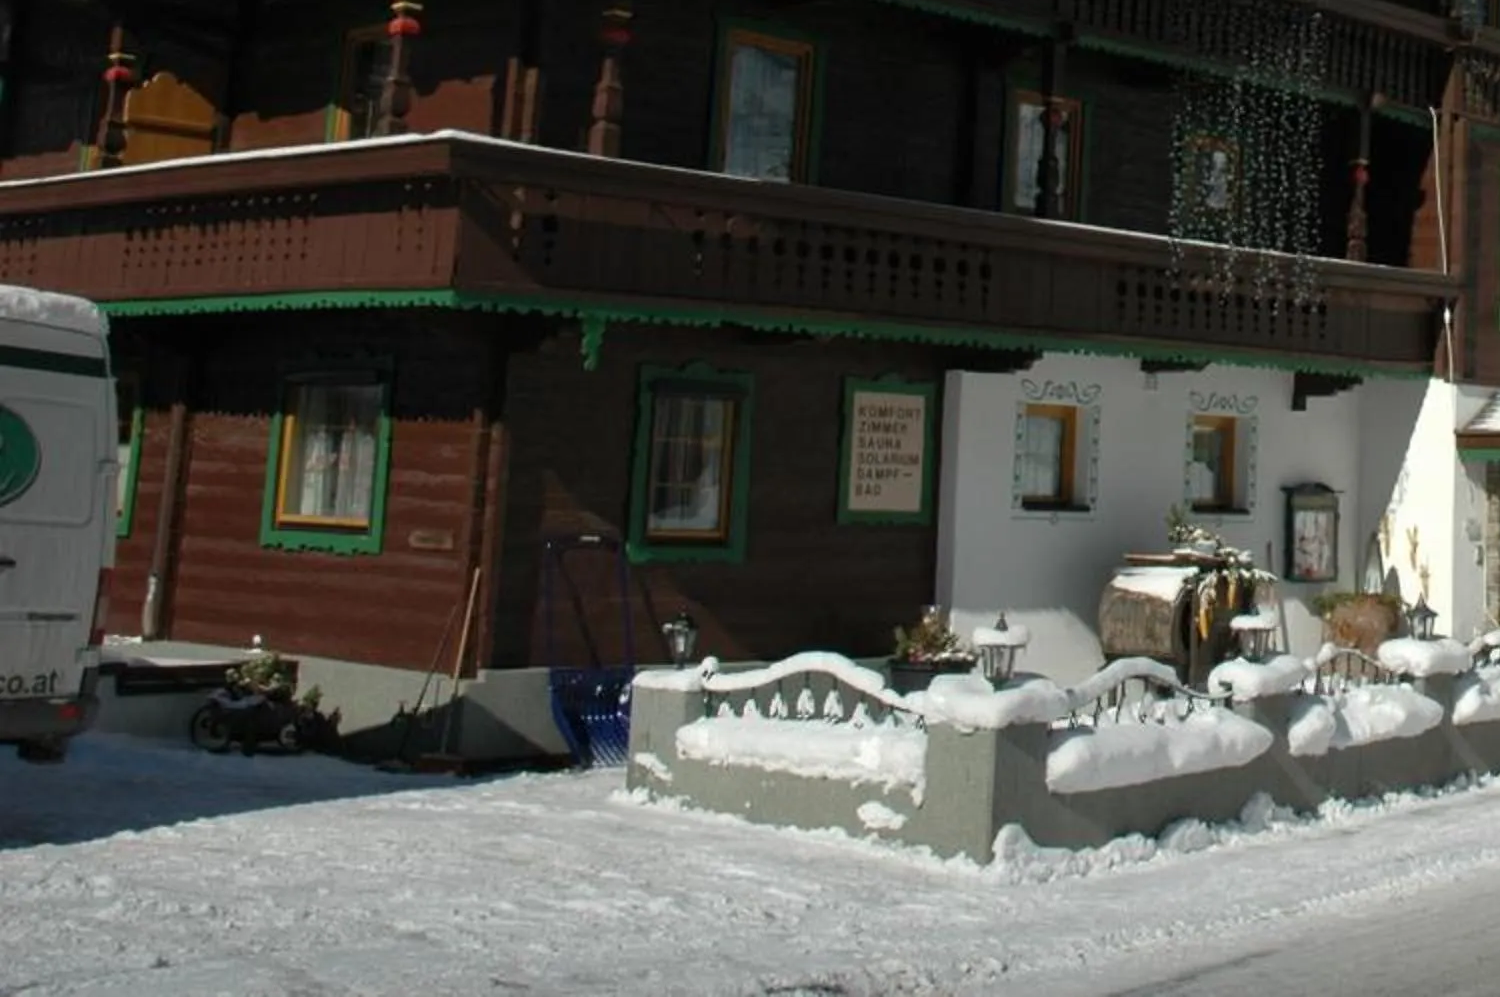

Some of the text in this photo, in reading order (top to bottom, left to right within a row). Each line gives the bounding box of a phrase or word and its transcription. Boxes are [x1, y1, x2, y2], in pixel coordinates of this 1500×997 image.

[857, 406, 921, 420] KOMFORT
[857, 436, 902, 450] SAUNA
[858, 453, 920, 466] SOLARIUM
[855, 483, 882, 497] BAD
